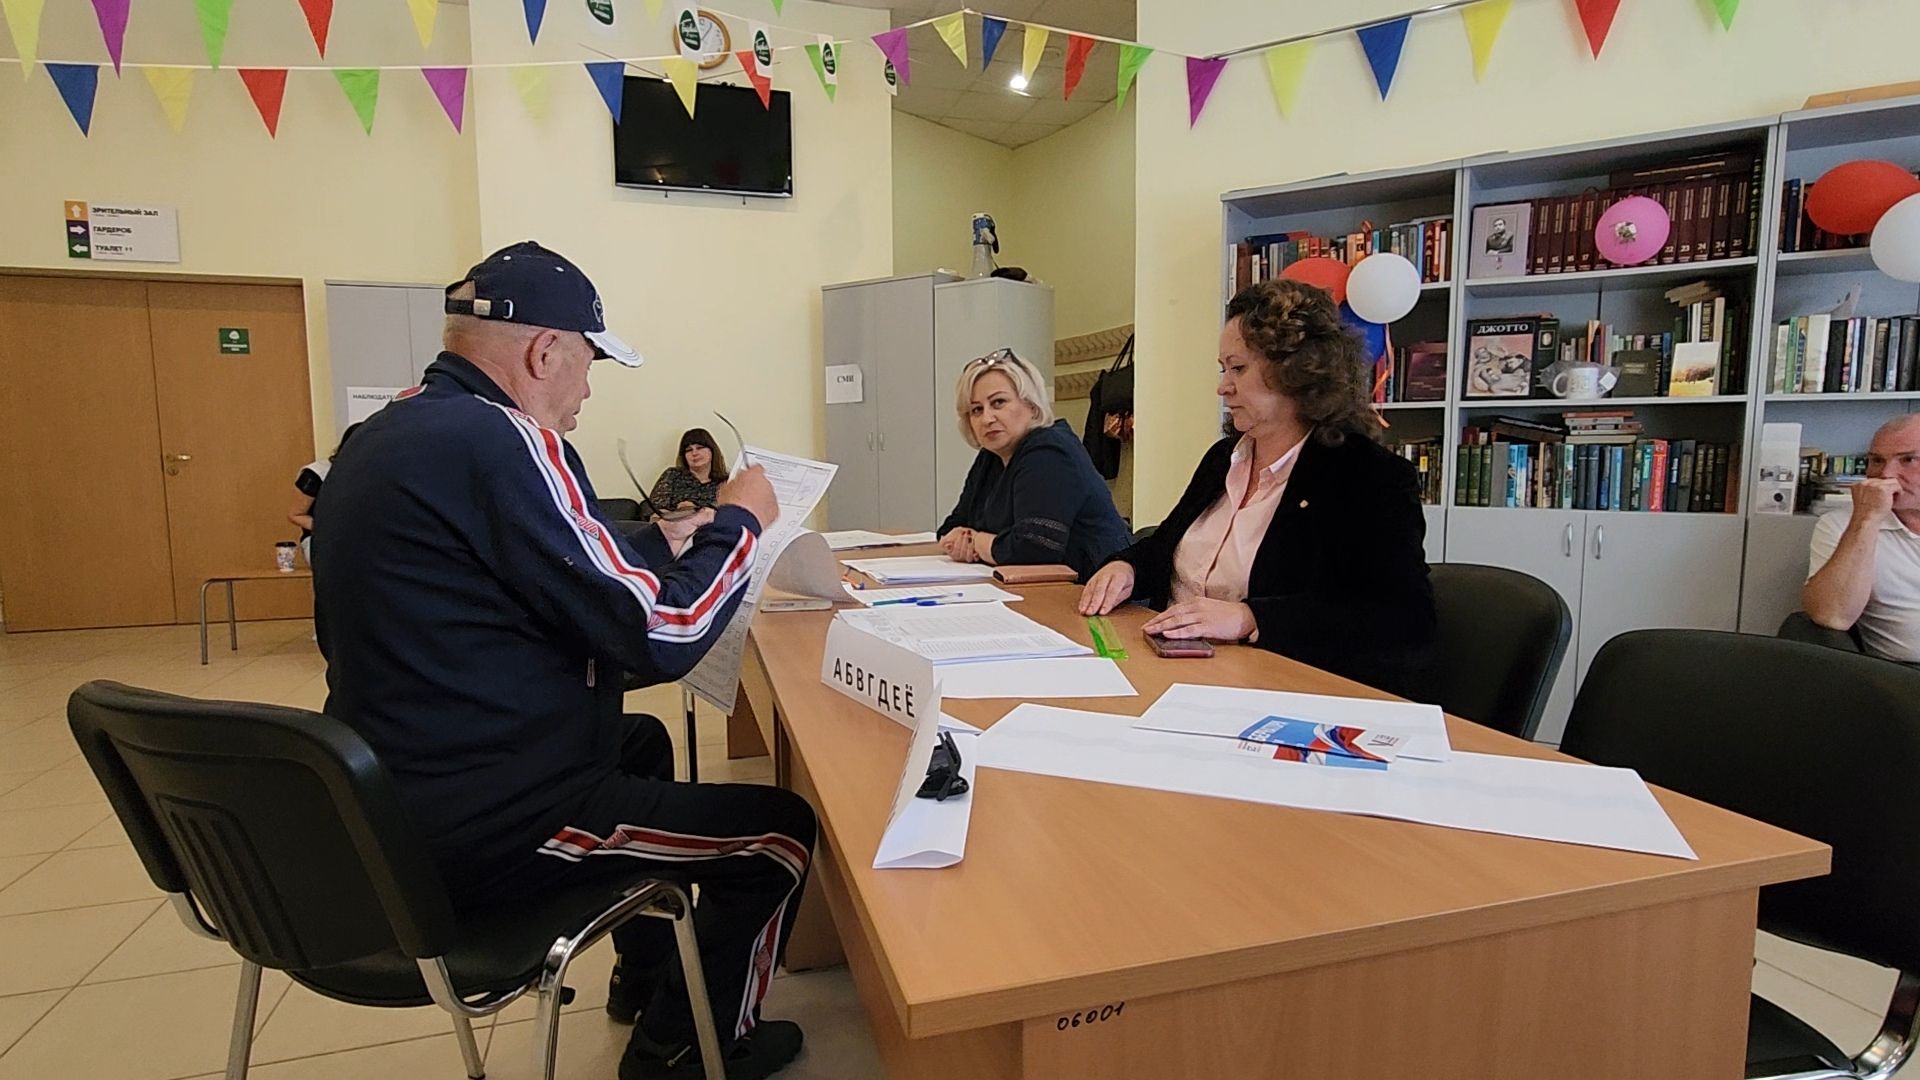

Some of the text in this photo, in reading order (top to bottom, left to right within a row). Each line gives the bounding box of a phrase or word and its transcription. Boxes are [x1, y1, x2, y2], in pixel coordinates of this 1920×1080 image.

[92, 207, 142, 216] ЗРИТЕЛЬНЫЙ
[93, 226, 132, 234] ГАРДЕРОБ
[1476, 323, 1529, 334] ДЖОТТО
[836, 375, 855, 383] СМИ
[833, 657, 915, 718] АБВГДЕЁ
[1056, 1001, 1126, 1031] 06001
